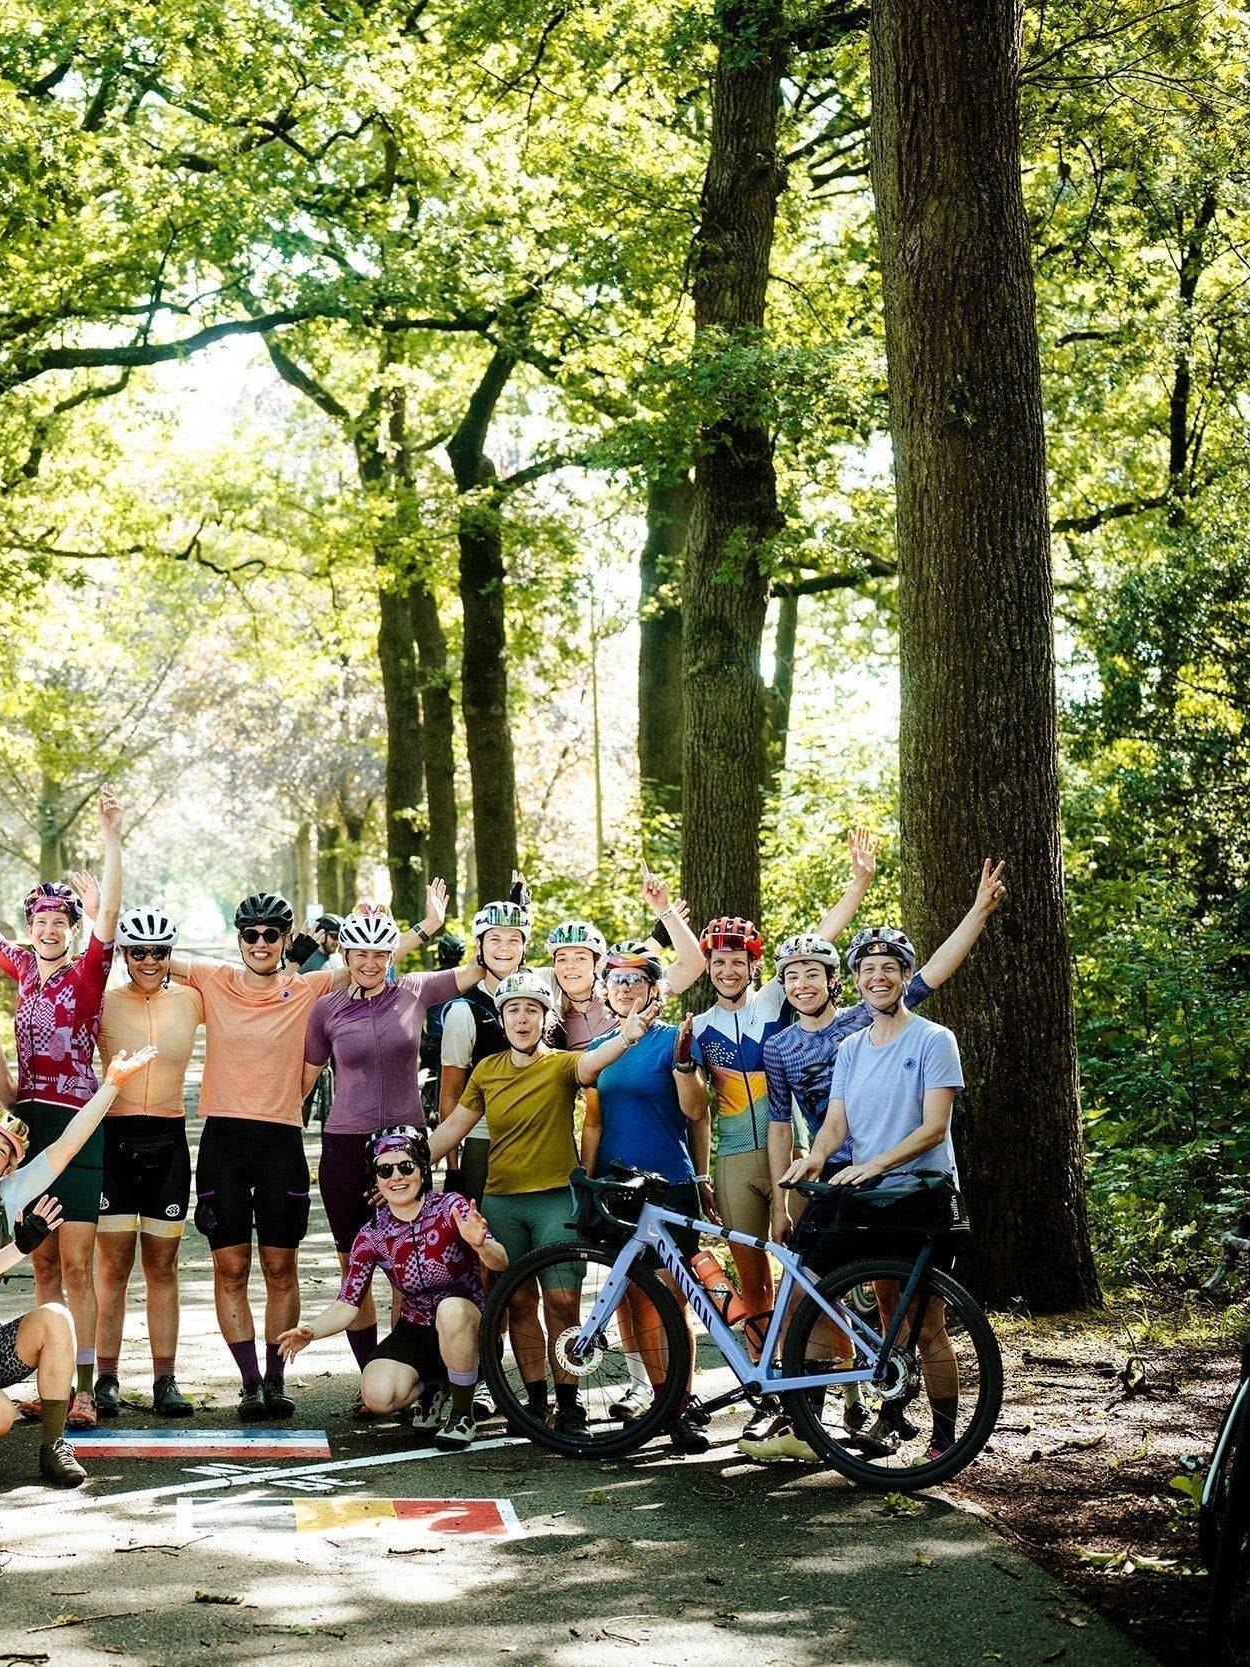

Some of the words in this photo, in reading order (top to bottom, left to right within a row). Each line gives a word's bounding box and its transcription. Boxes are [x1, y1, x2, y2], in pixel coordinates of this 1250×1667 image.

[950, 1195, 959, 1220] tailfin
[658, 1239, 712, 1333] CANYON
[270, 1475, 367, 1492] BE
